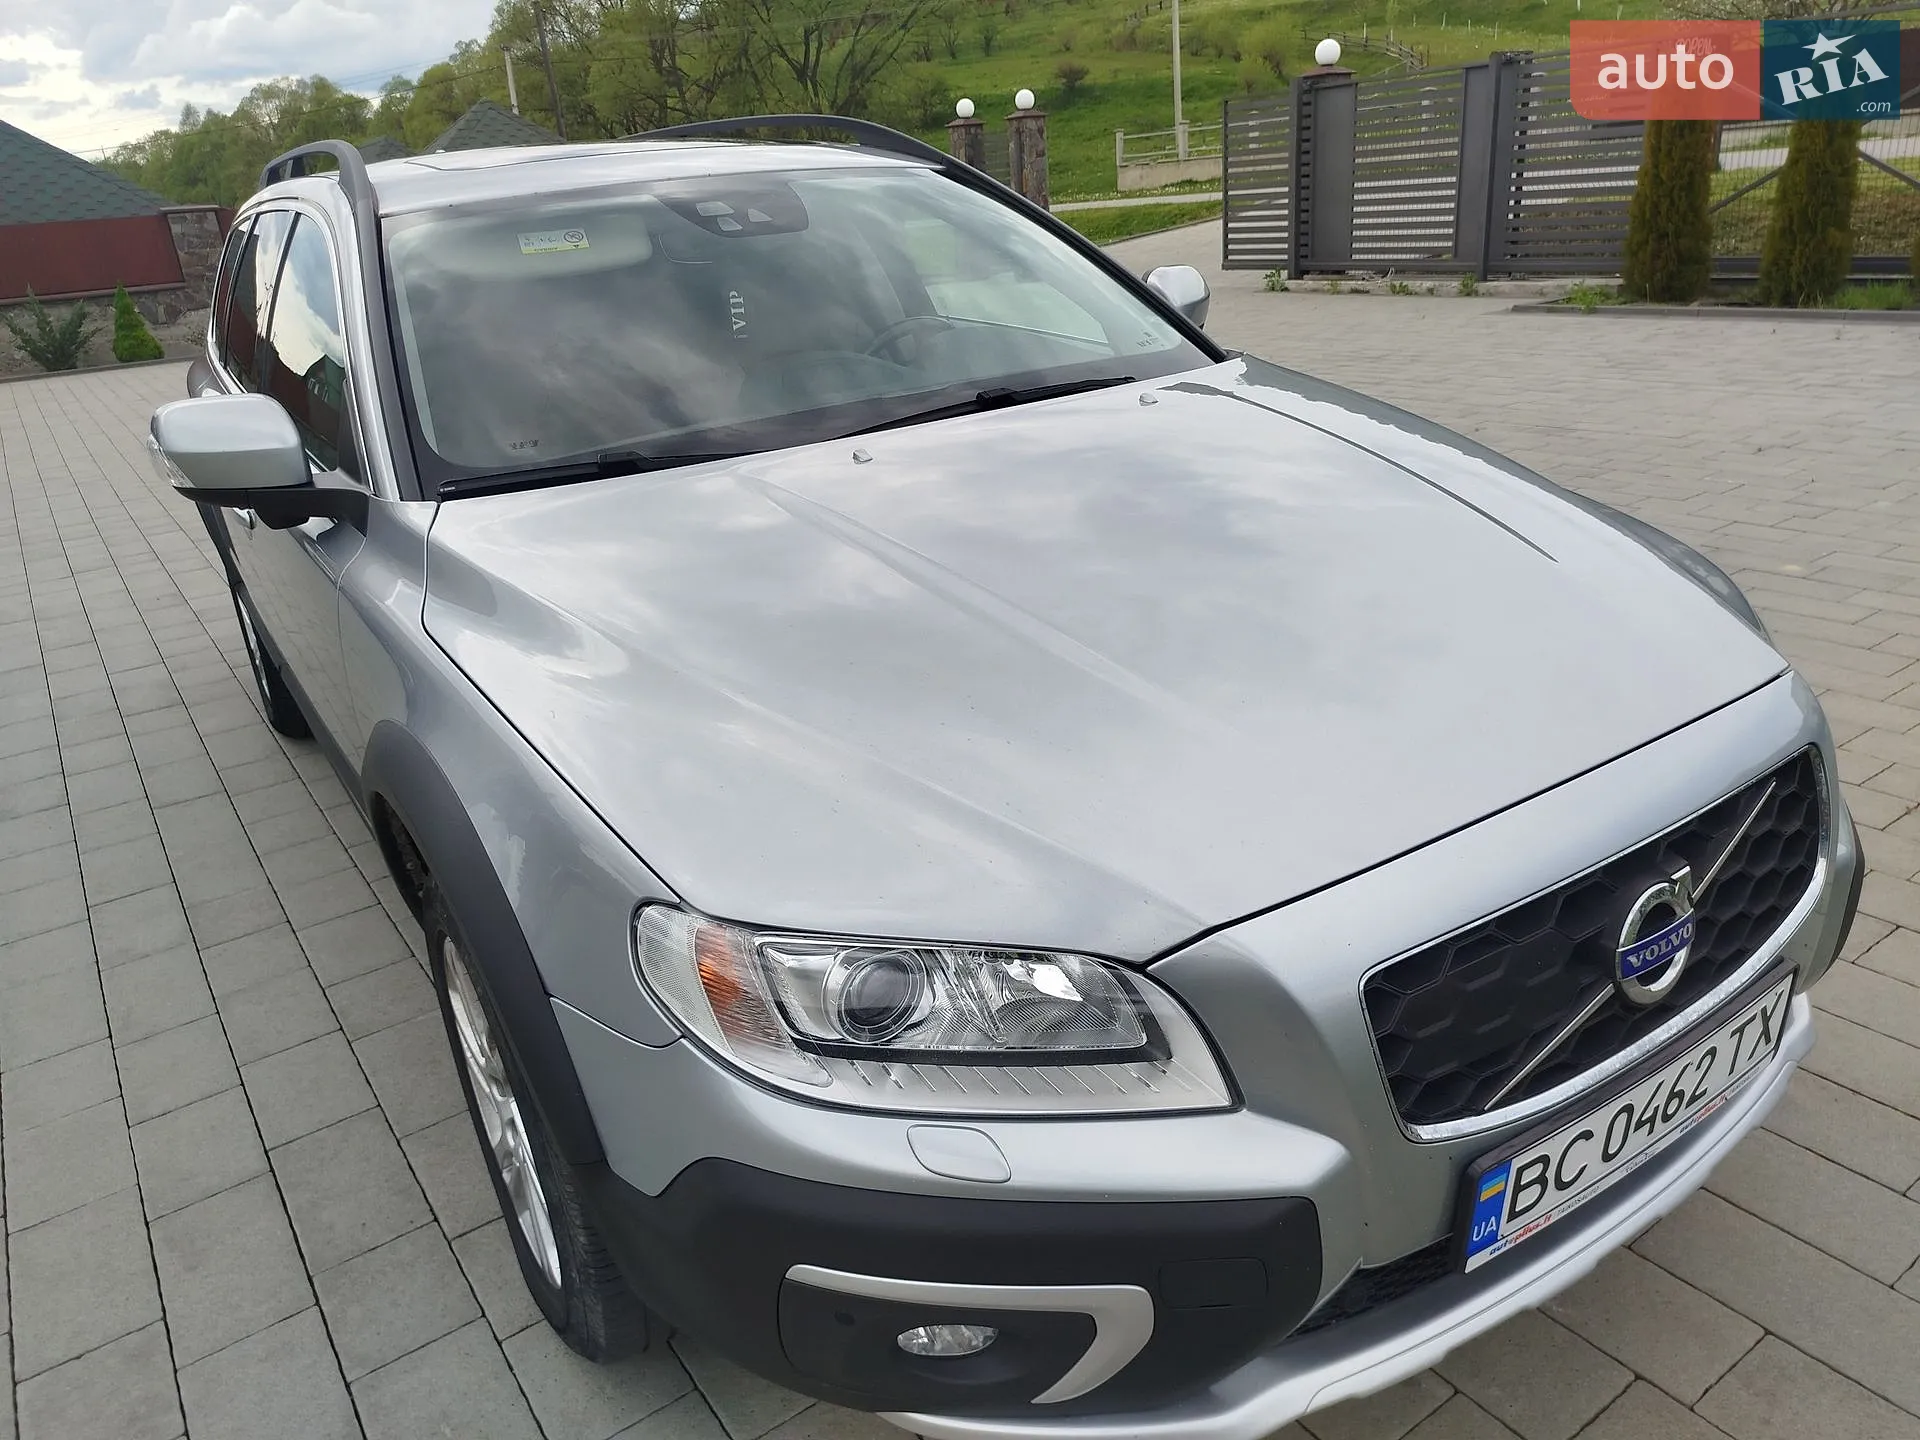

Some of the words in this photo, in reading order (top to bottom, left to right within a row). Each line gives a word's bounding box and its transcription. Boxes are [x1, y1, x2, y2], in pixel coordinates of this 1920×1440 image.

[1626, 922, 1693, 968] VOLVO
[1506, 1129, 1594, 1224] BC
[1600, 1045, 1719, 1164] 0462
[1727, 988, 1784, 1077] TX
[1472, 1215, 1497, 1242] UA
